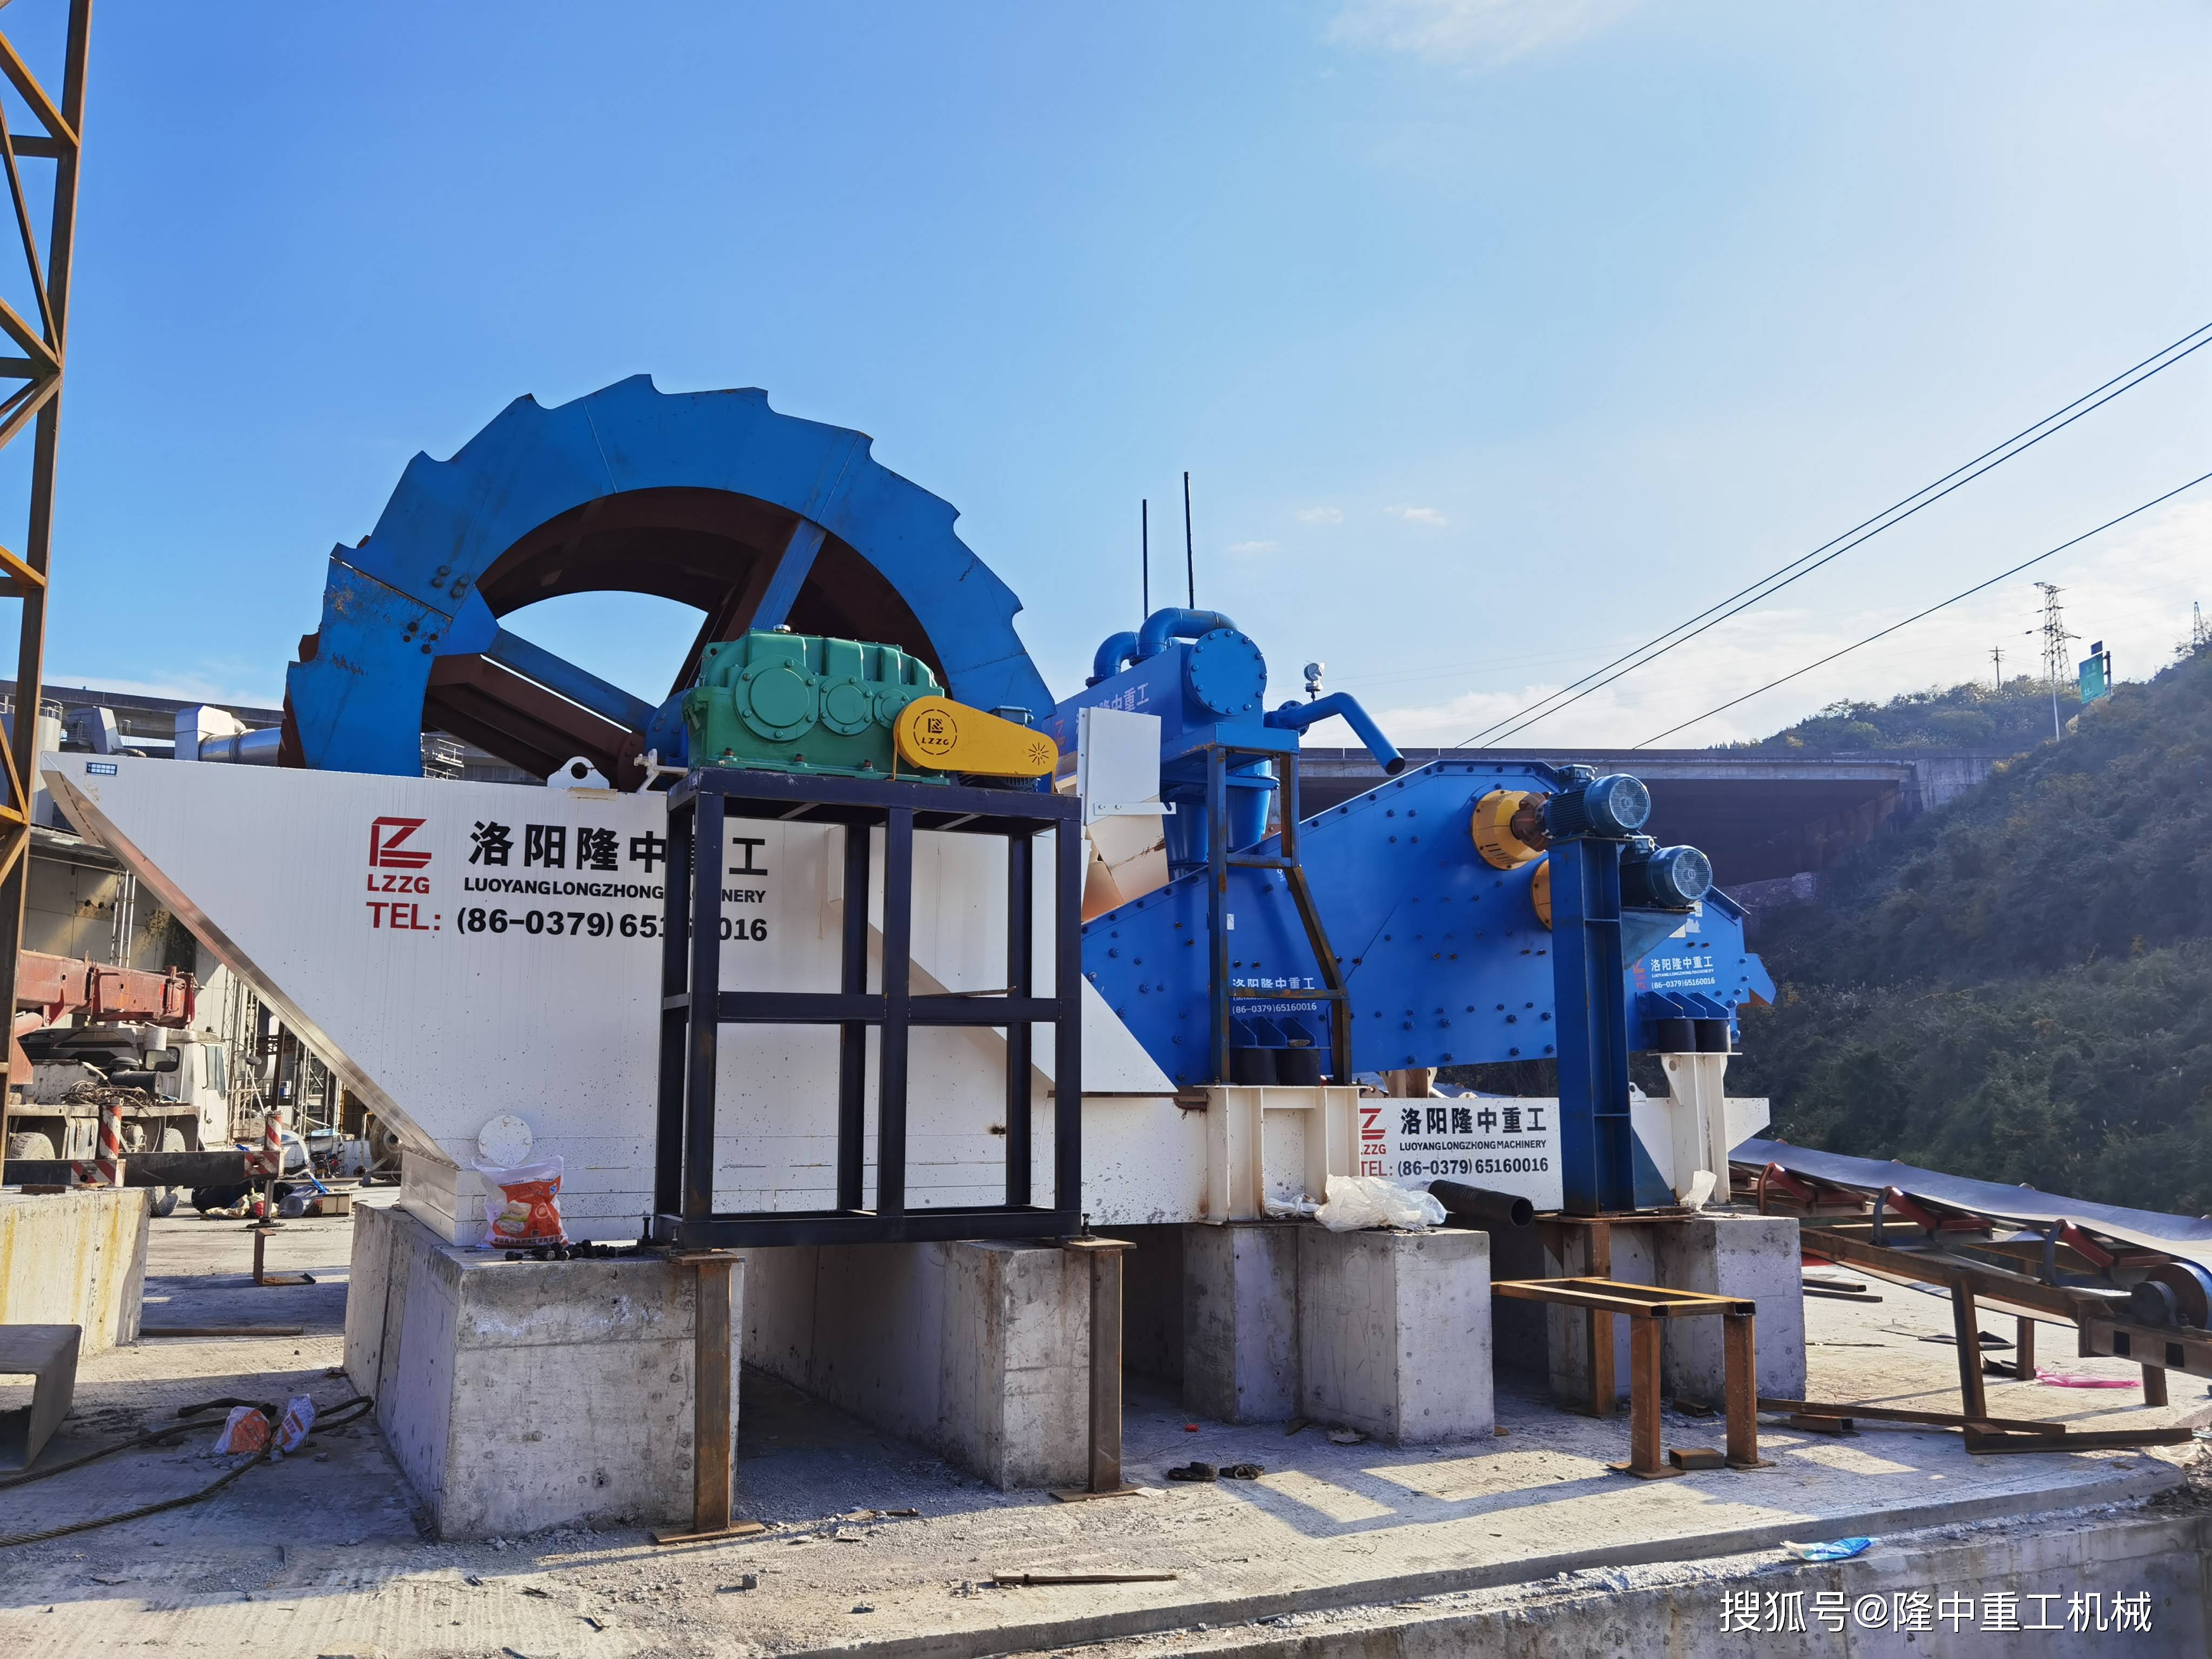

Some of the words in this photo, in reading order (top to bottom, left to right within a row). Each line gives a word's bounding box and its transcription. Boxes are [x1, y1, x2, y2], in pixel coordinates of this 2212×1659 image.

[921, 737, 949, 745] LZZG
[468, 821, 768, 876] 洛阳隆中工
[367, 874, 430, 894] LZZG
[366, 901, 441, 931] TEL:
[457, 907, 767, 941] (86-0379)65016
[1650, 955, 1714, 972] 洛阳隆中重工
[1651, 977, 1716, 989] (86-0379)65160016
[1232, 1002, 1317, 1014] (86-0379)65160016
[1400, 1107, 1547, 1135] 洛阳隆中重工
[1360, 1143, 1387, 1155] ZZG
